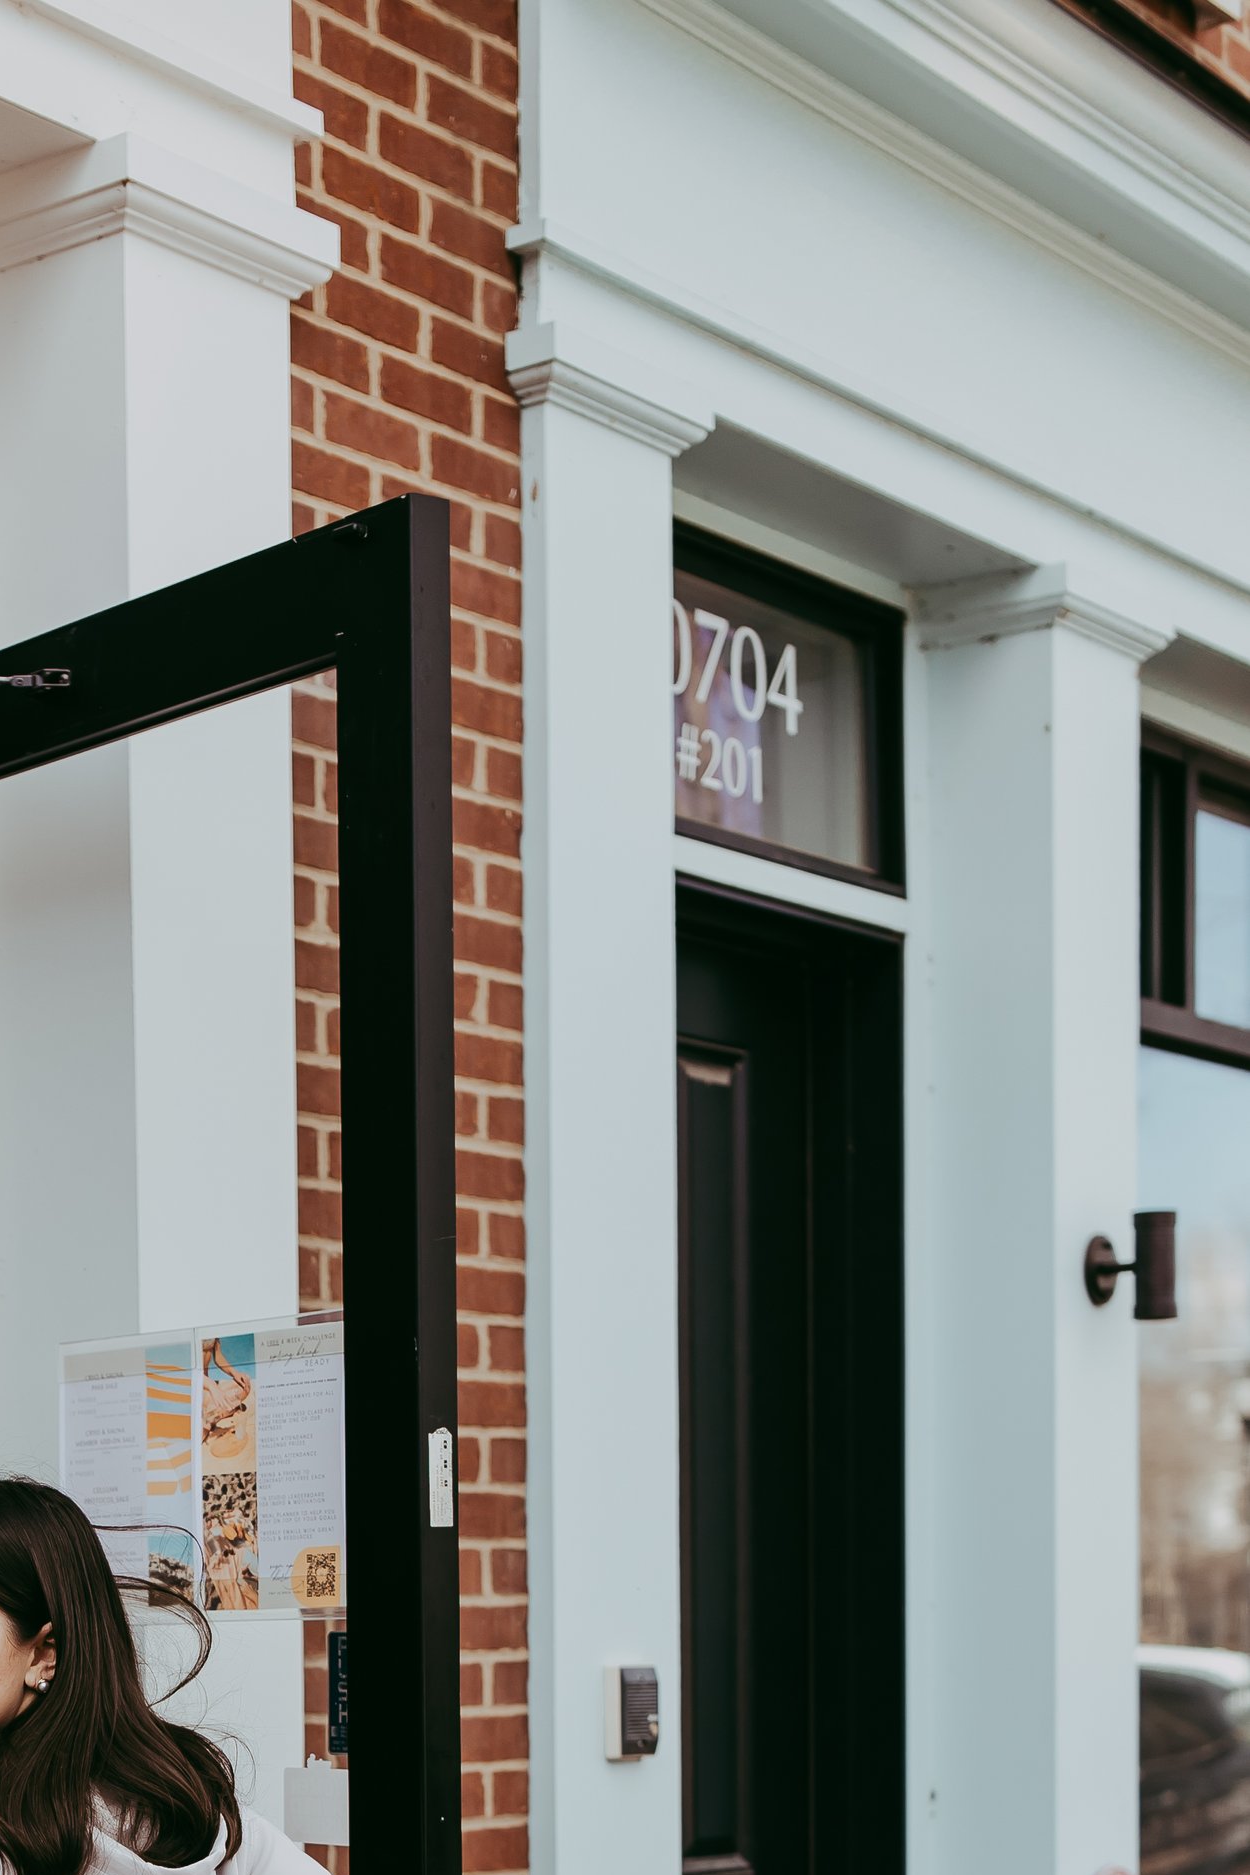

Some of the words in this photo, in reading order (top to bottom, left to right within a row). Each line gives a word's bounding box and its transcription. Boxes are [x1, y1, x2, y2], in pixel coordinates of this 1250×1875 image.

[676, 722, 764, 805] #201
[304, 1333, 336, 1342] CHALLENGE
[305, 1359, 330, 1367] READY
